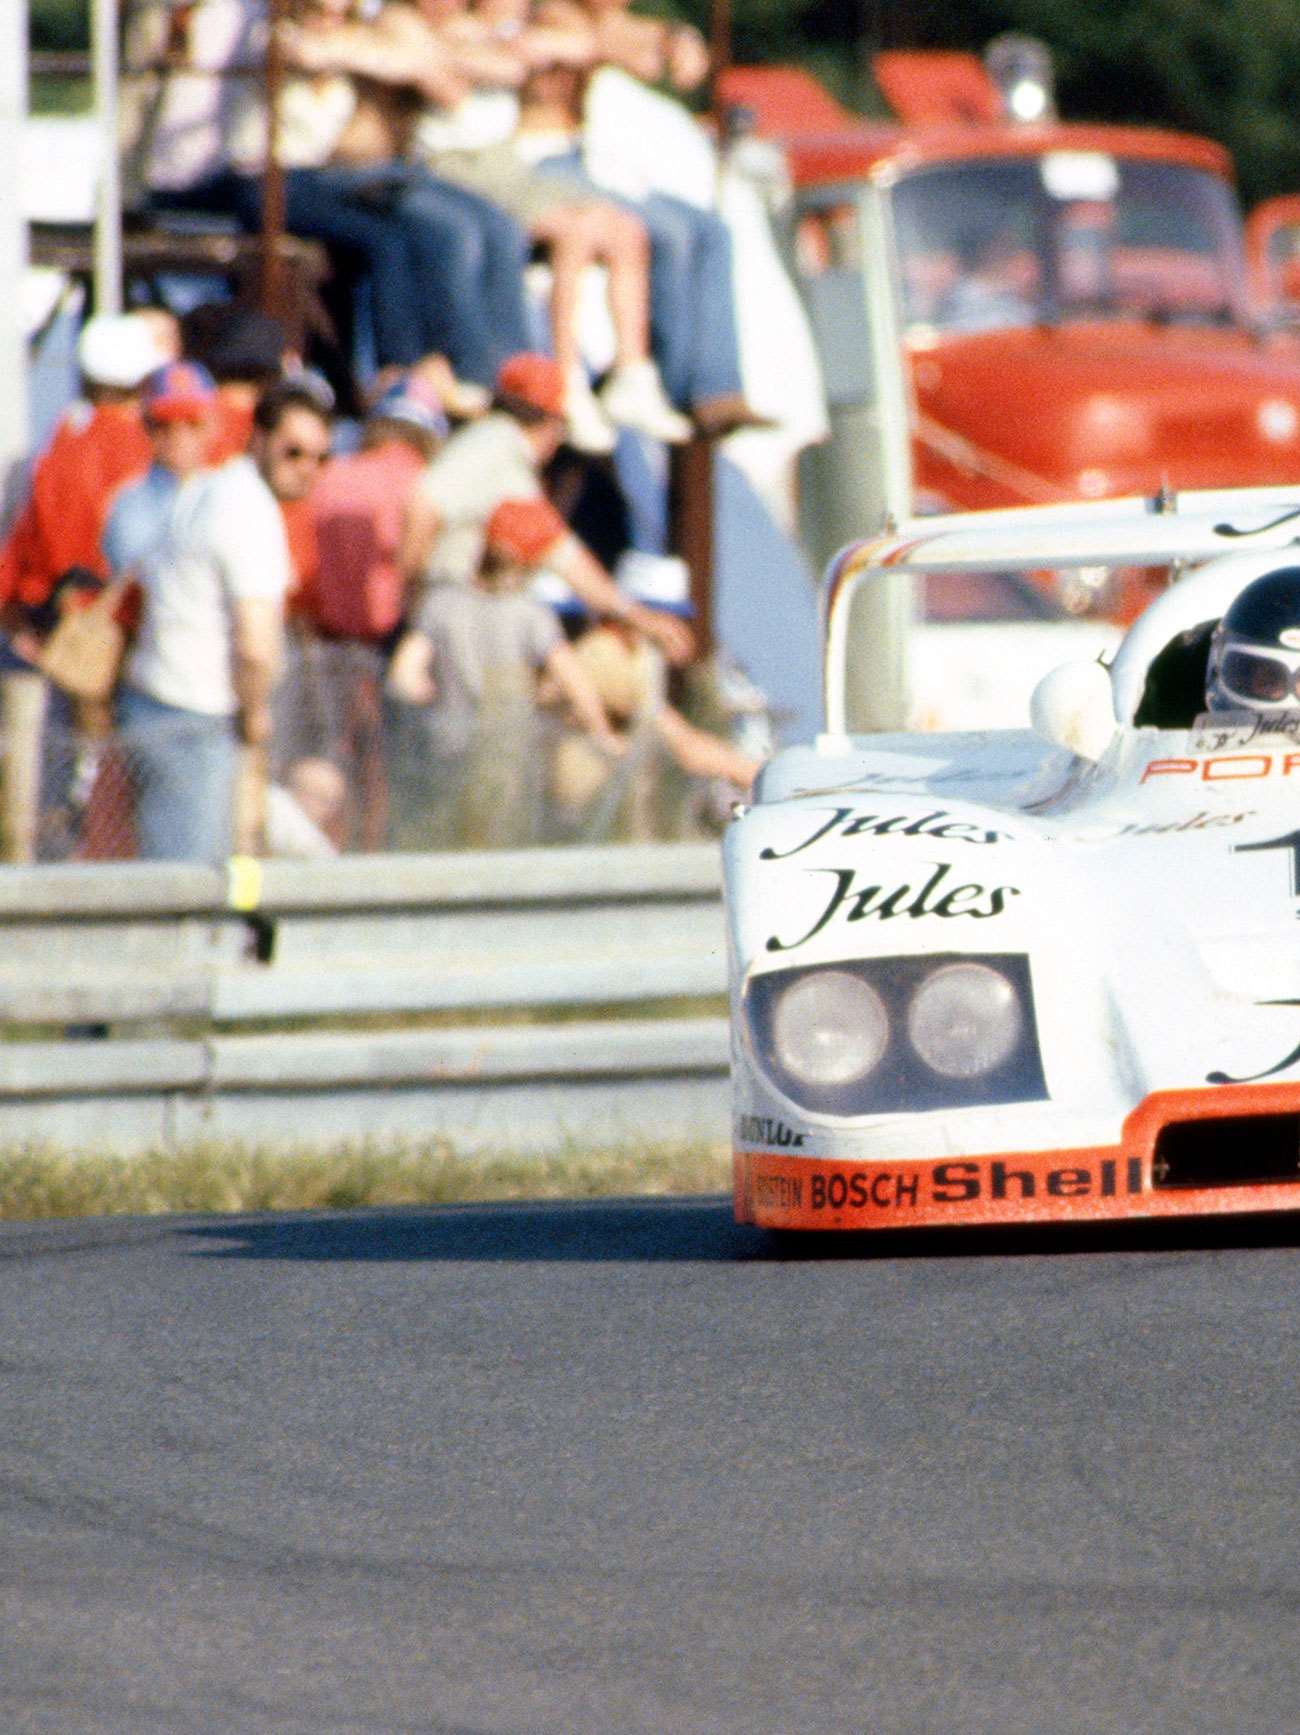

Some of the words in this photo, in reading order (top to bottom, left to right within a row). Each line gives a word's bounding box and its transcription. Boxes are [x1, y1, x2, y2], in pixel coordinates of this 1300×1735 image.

[760, 807, 1015, 860] Jules
[766, 862, 1021, 951] Jules
[811, 1173, 919, 1210] BOSCH
[932, 1156, 1142, 1203] Shell
